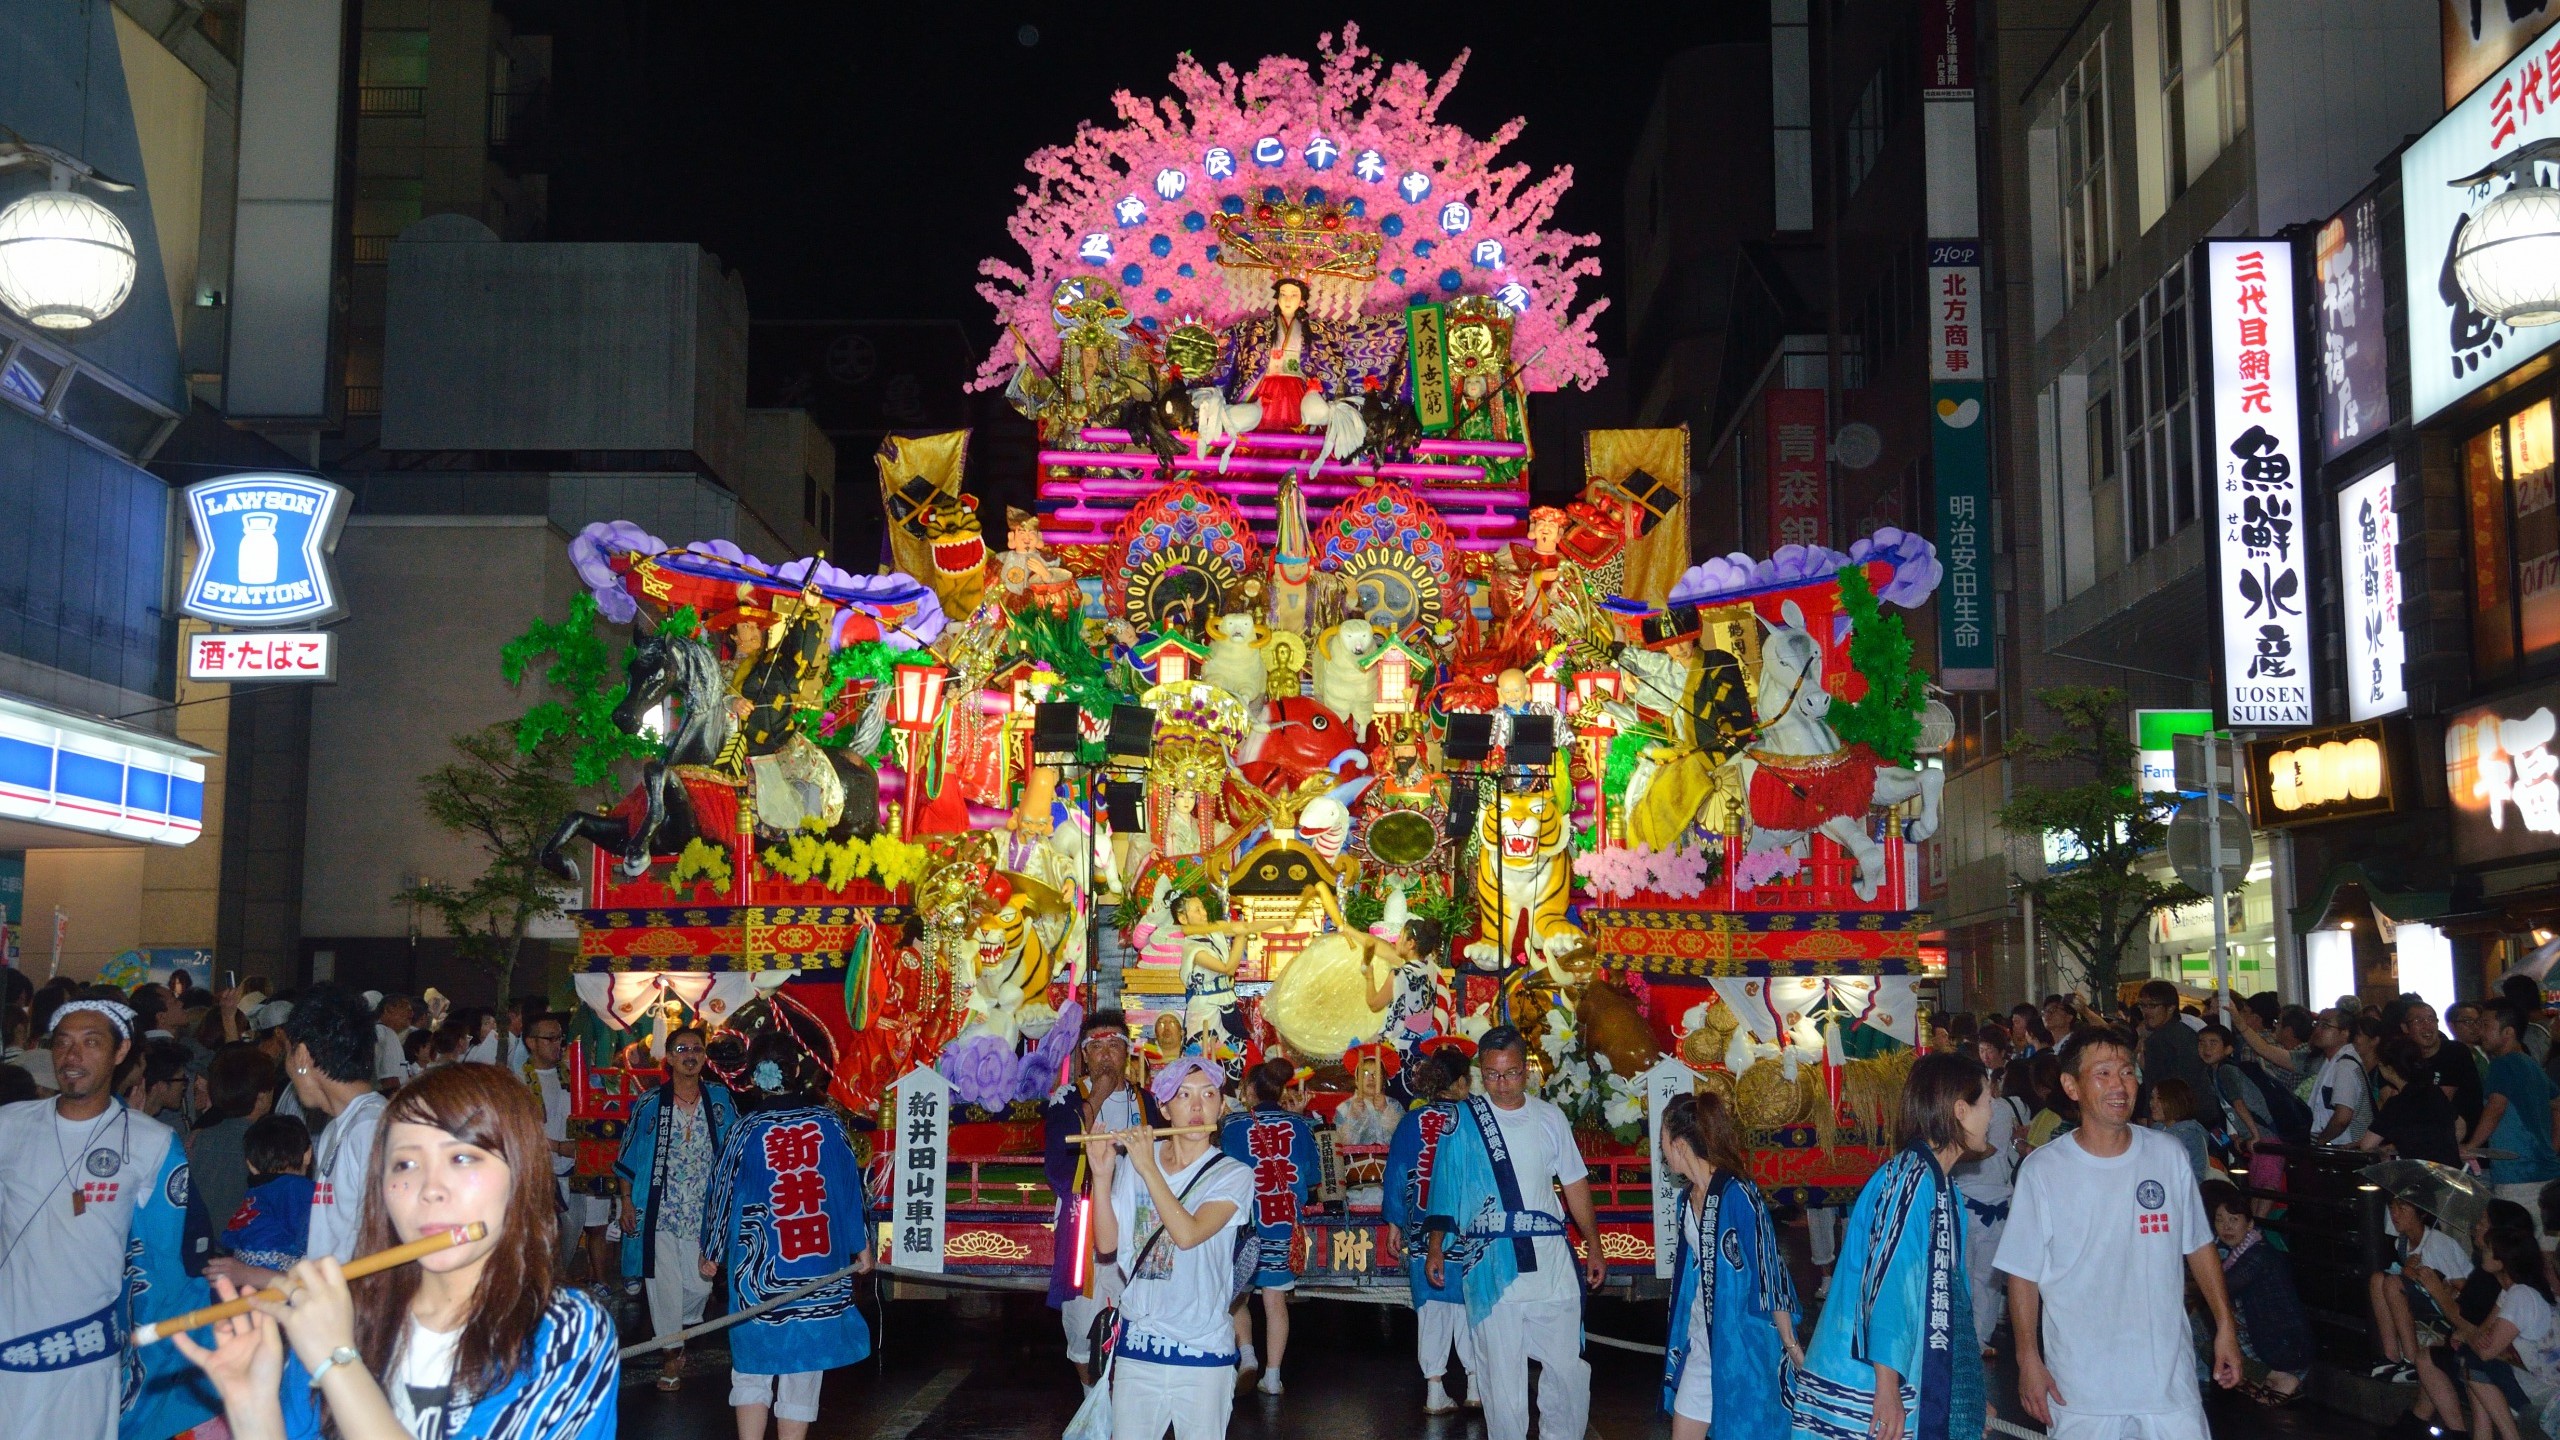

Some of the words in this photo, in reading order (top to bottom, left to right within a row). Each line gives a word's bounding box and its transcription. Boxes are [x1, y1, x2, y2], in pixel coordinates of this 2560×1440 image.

[1116, 195, 1146, 223] 寅
[1157, 169, 1185, 198] 卯
[1205, 148, 1233, 176] 辰
[1305, 137, 1338, 168] 午
[1357, 150, 1385, 183] 未
[1402, 172, 1430, 203] 申
[1443, 203, 1470, 231] 酉
[1942, 273, 1969, 373] 北方商事
[2235, 250, 2272, 414] 三代目網元
[204, 490, 317, 517] LAWSON
[1777, 422, 1819, 545] 青森銀
[2225, 461, 2238, 492] うお
[1949, 495, 1980, 648] 明治安田生命
[2227, 513, 2239, 543] せん
[2230, 424, 2303, 679] 魚鮮水産
[202, 579, 313, 605] STATION
[2232, 705, 2310, 722] SUISAN
[2235, 686, 2306, 703] UOSEN
[652, 1105, 673, 1188] 新井田附祭振興会
[763, 1120, 833, 1262] 新井田
[903, 1091, 939, 1254] 新井田山車組
[1248, 1121, 1300, 1228] 新井田
[1928, 1191, 1952, 1351] 新井田附祭振興会
[1, 1319, 107, 1367] 新井田
